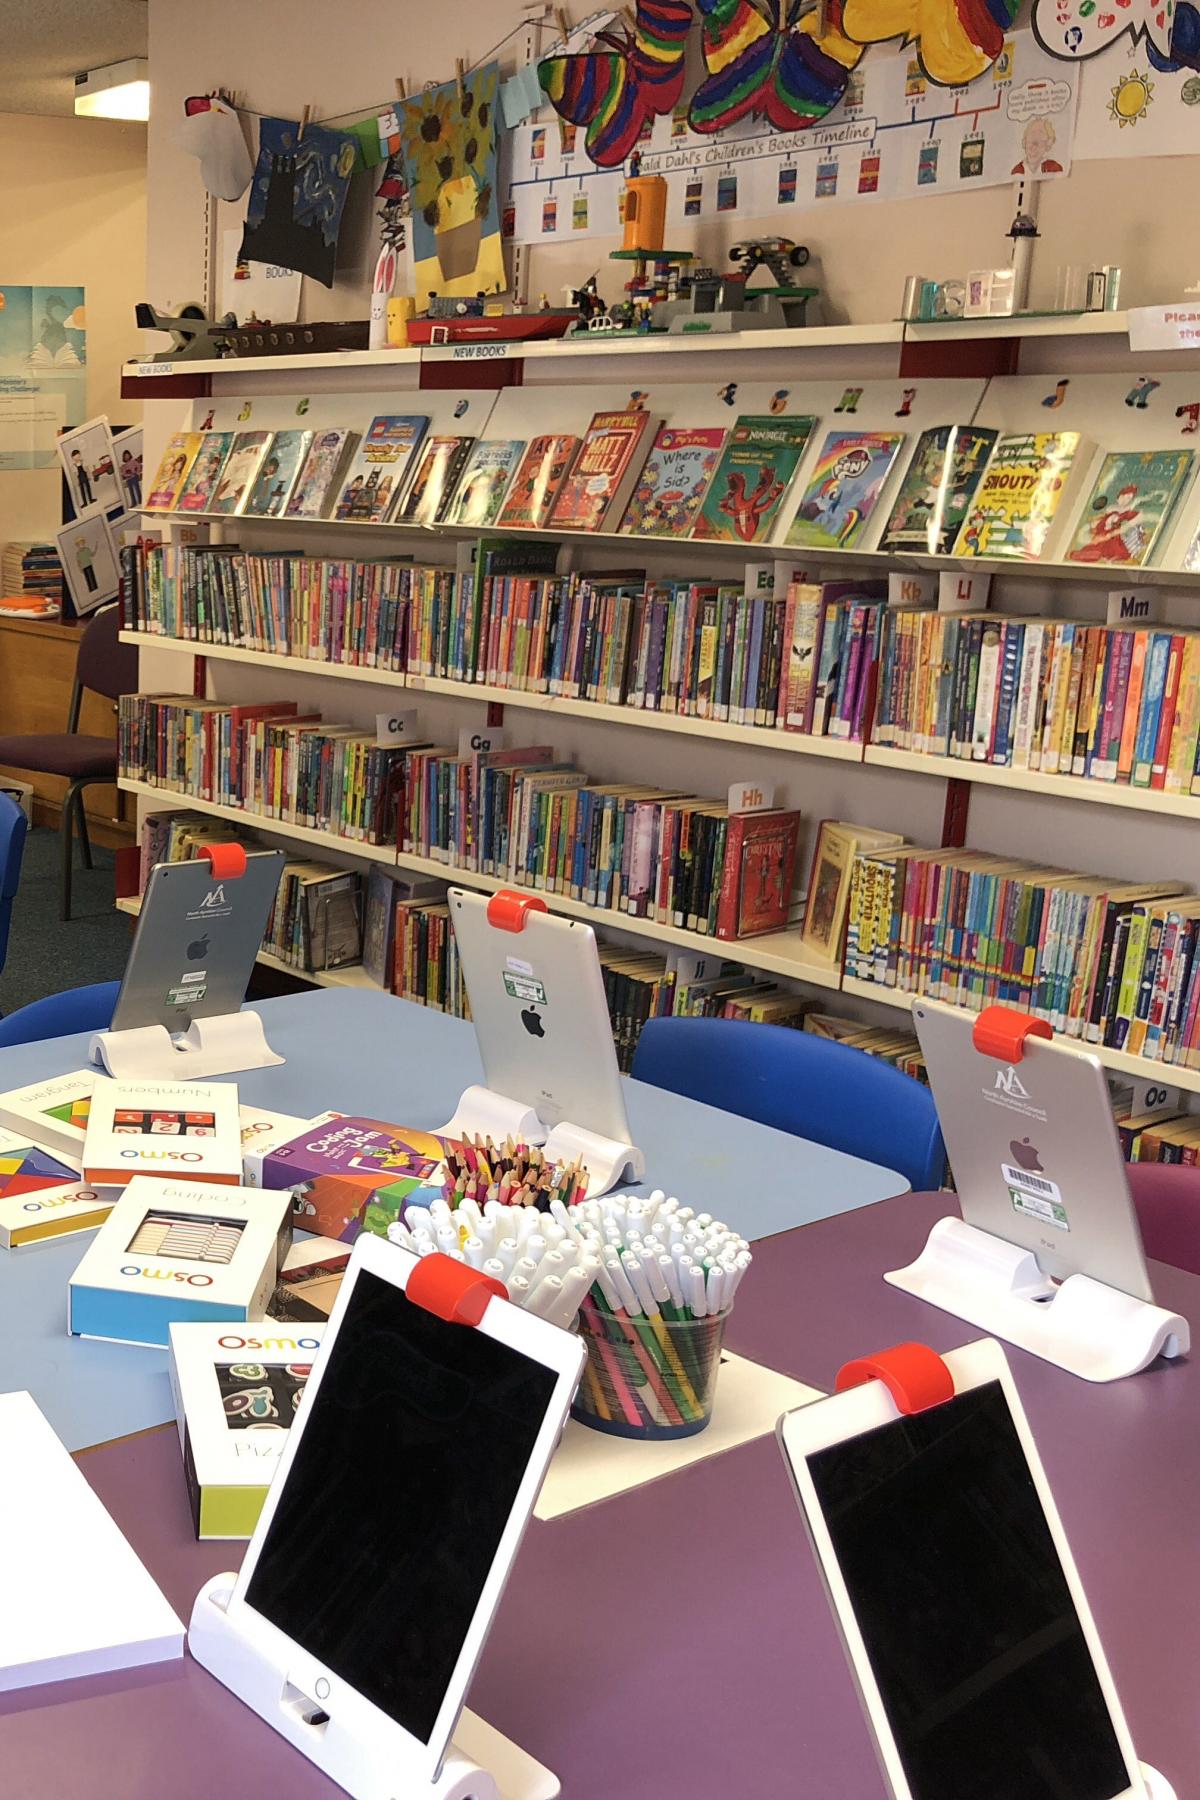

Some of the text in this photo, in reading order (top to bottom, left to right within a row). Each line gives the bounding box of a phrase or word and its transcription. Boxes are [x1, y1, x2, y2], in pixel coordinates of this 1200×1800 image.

[665, 150, 702, 168] Dahl's
[705, 140, 765, 162] Children's
[768, 132, 806, 152] Books
[812, 124, 870, 145] Timeline
[452, 345, 507, 358] NEW BOOKS
[589, 436, 625, 454] MATT
[580, 454, 619, 472] MILLZ
[663, 450, 701, 465] Where
[675, 464, 685, 474] is
[664, 476, 690, 489] Sid?
[982, 475, 1037, 490] SHOUTY
[180, 529, 197, 543] Bb
[757, 571, 775, 588] Ee
[957, 579, 972, 600] Ll
[1119, 596, 1150, 619] Mm
[388, 718, 404, 733] Cc
[470, 735, 491, 752] Gg
[741, 789, 763, 809] Hh
[117, 1085, 212, 1098] Numbers
[1144, 1087, 1167, 1107] Oo
[305, 1126, 364, 1153] Coding
[341, 1130, 384, 1148] Jam
[119, 1148, 204, 1163] Osmo
[23, 1190, 98, 1213] Osmo
[119, 1265, 214, 1287] Osmo
[217, 1335, 321, 1350] Osmo
